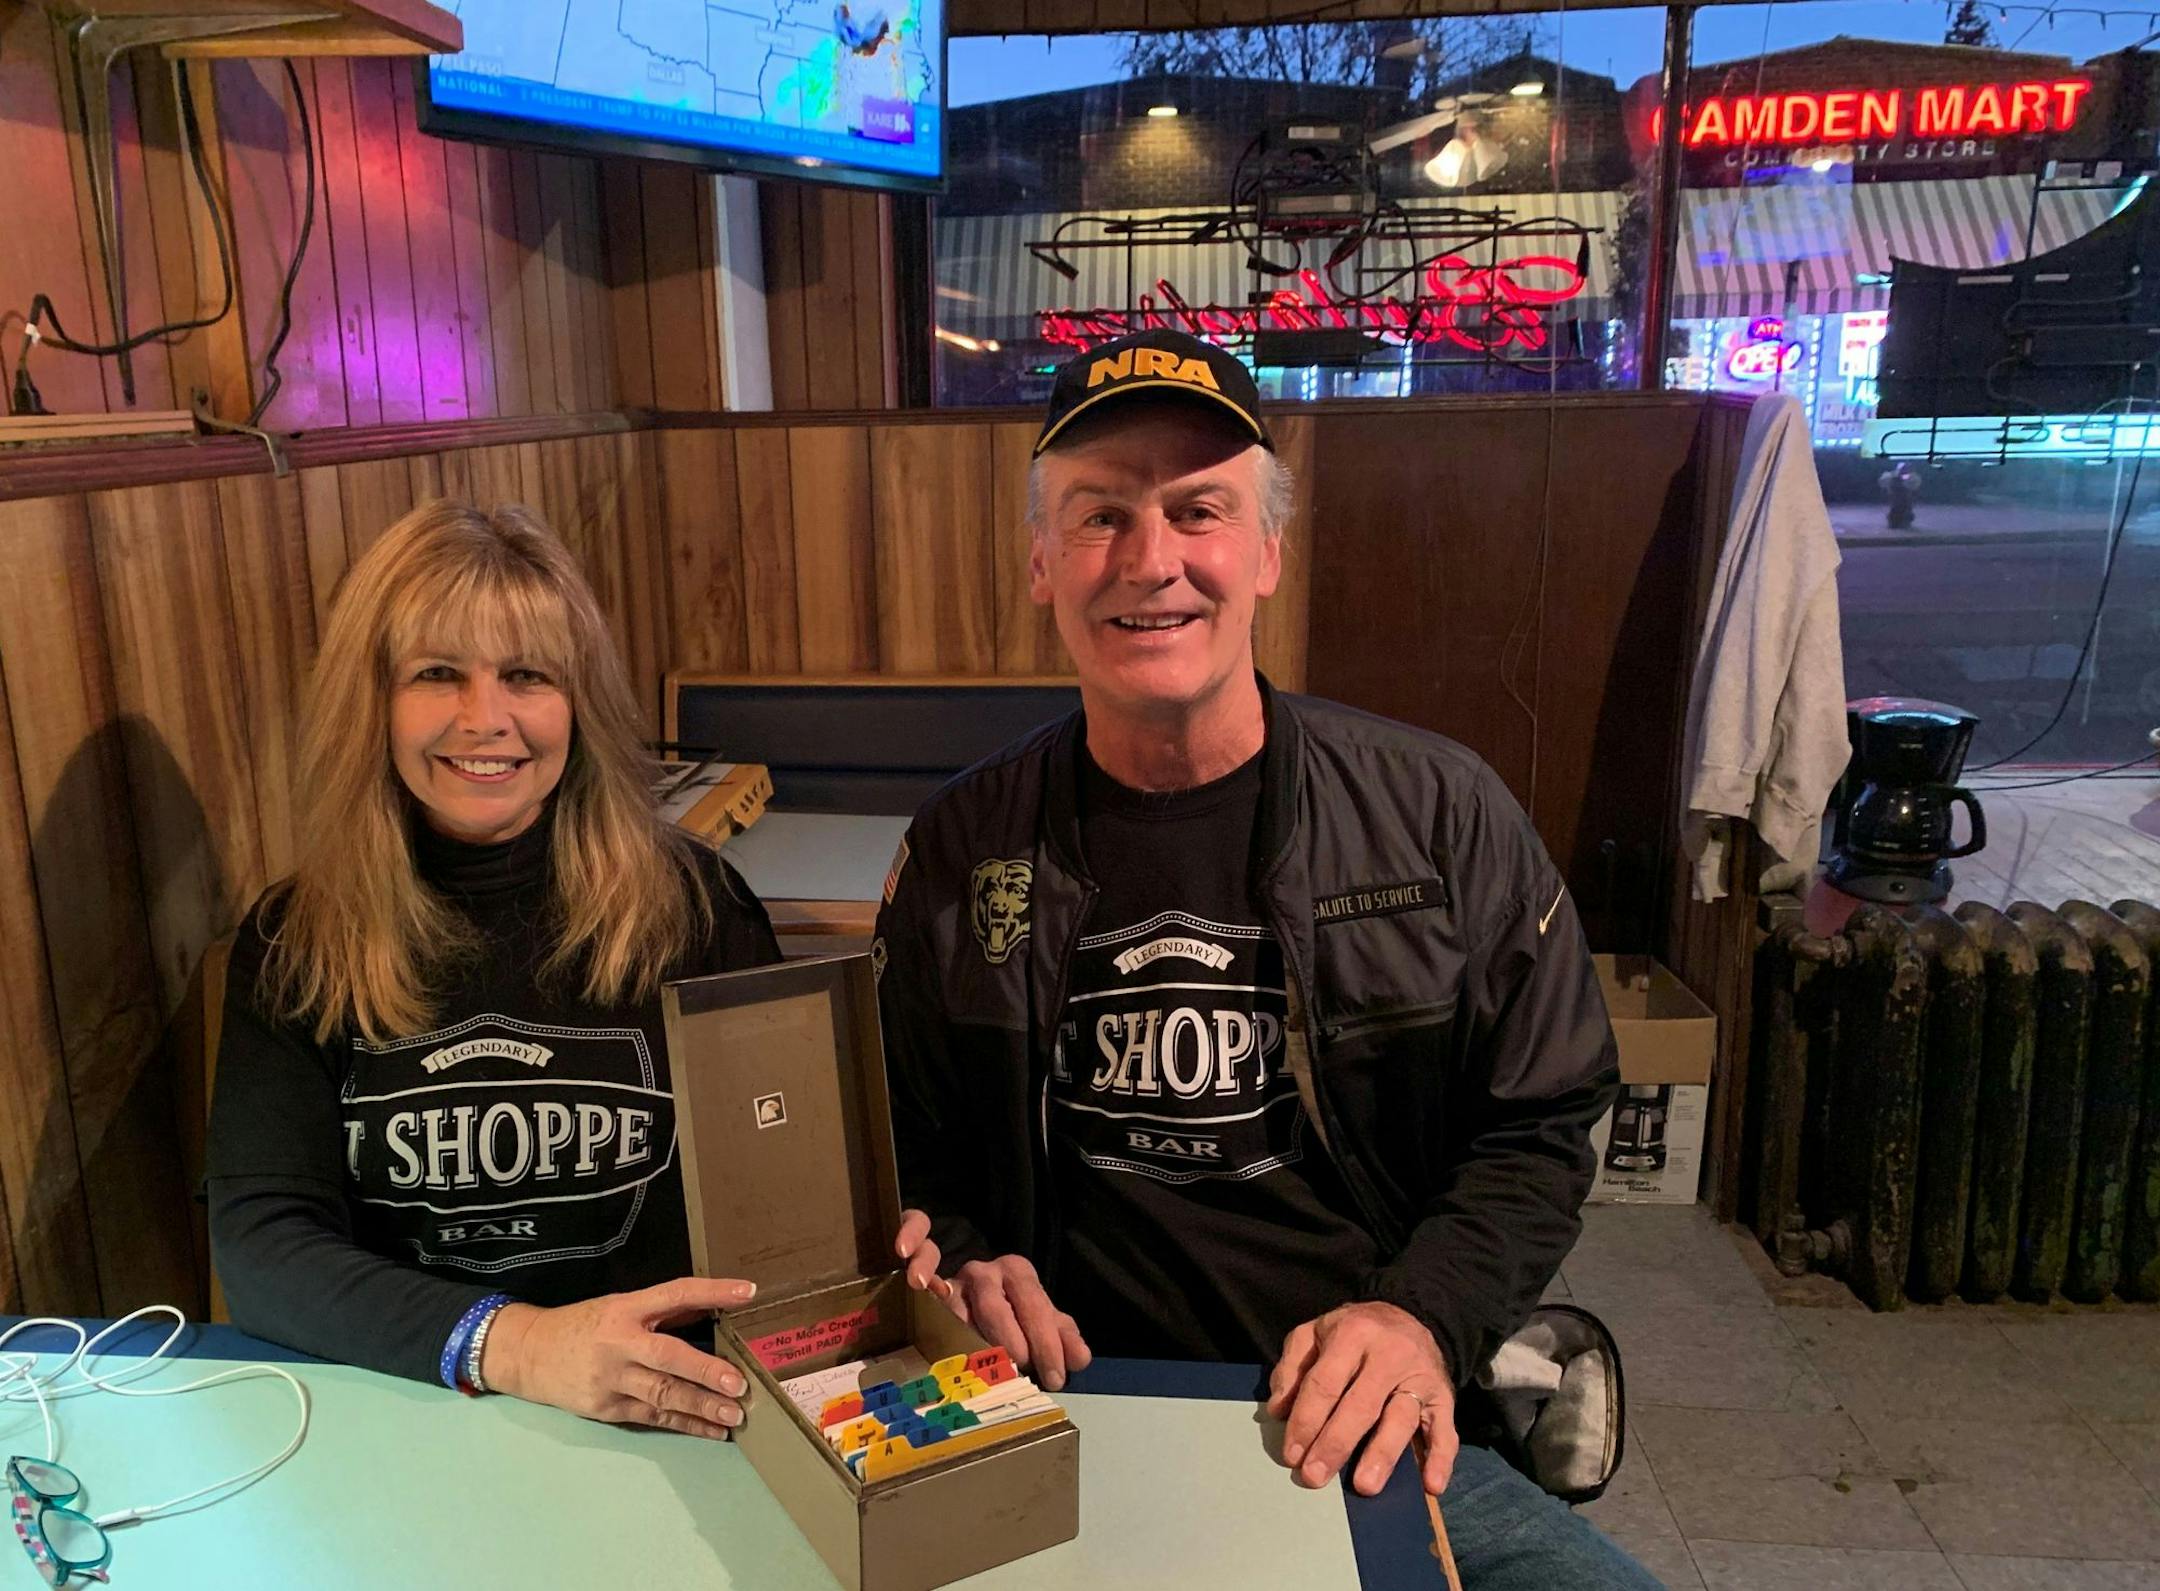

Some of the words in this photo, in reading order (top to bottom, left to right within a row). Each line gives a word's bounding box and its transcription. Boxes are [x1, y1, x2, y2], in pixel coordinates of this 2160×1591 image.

[437, 74, 503, 97] NATIONAL
[1916, 80, 2090, 138] MART
[1905, 139, 1997, 160] STORE
[1755, 319, 1784, 337] ATM
[1086, 347, 1221, 391] NRA
[1355, 893, 1372, 912] TO
[1374, 885, 1424, 909] SERVICE
[1132, 938, 1214, 965] LEGENDARY
[442, 1042, 534, 1065] LEGENDARY
[385, 1101, 655, 1190] SHOPPE
[1125, 1131, 1223, 1158] BAR
[438, 1219, 538, 1243] BAR
[774, 1334, 793, 1347] No
[796, 1326, 825, 1342] More
[828, 1315, 864, 1333] Credit
[816, 1334, 843, 1351] PAID
[884, 1441, 894, 1457] A
